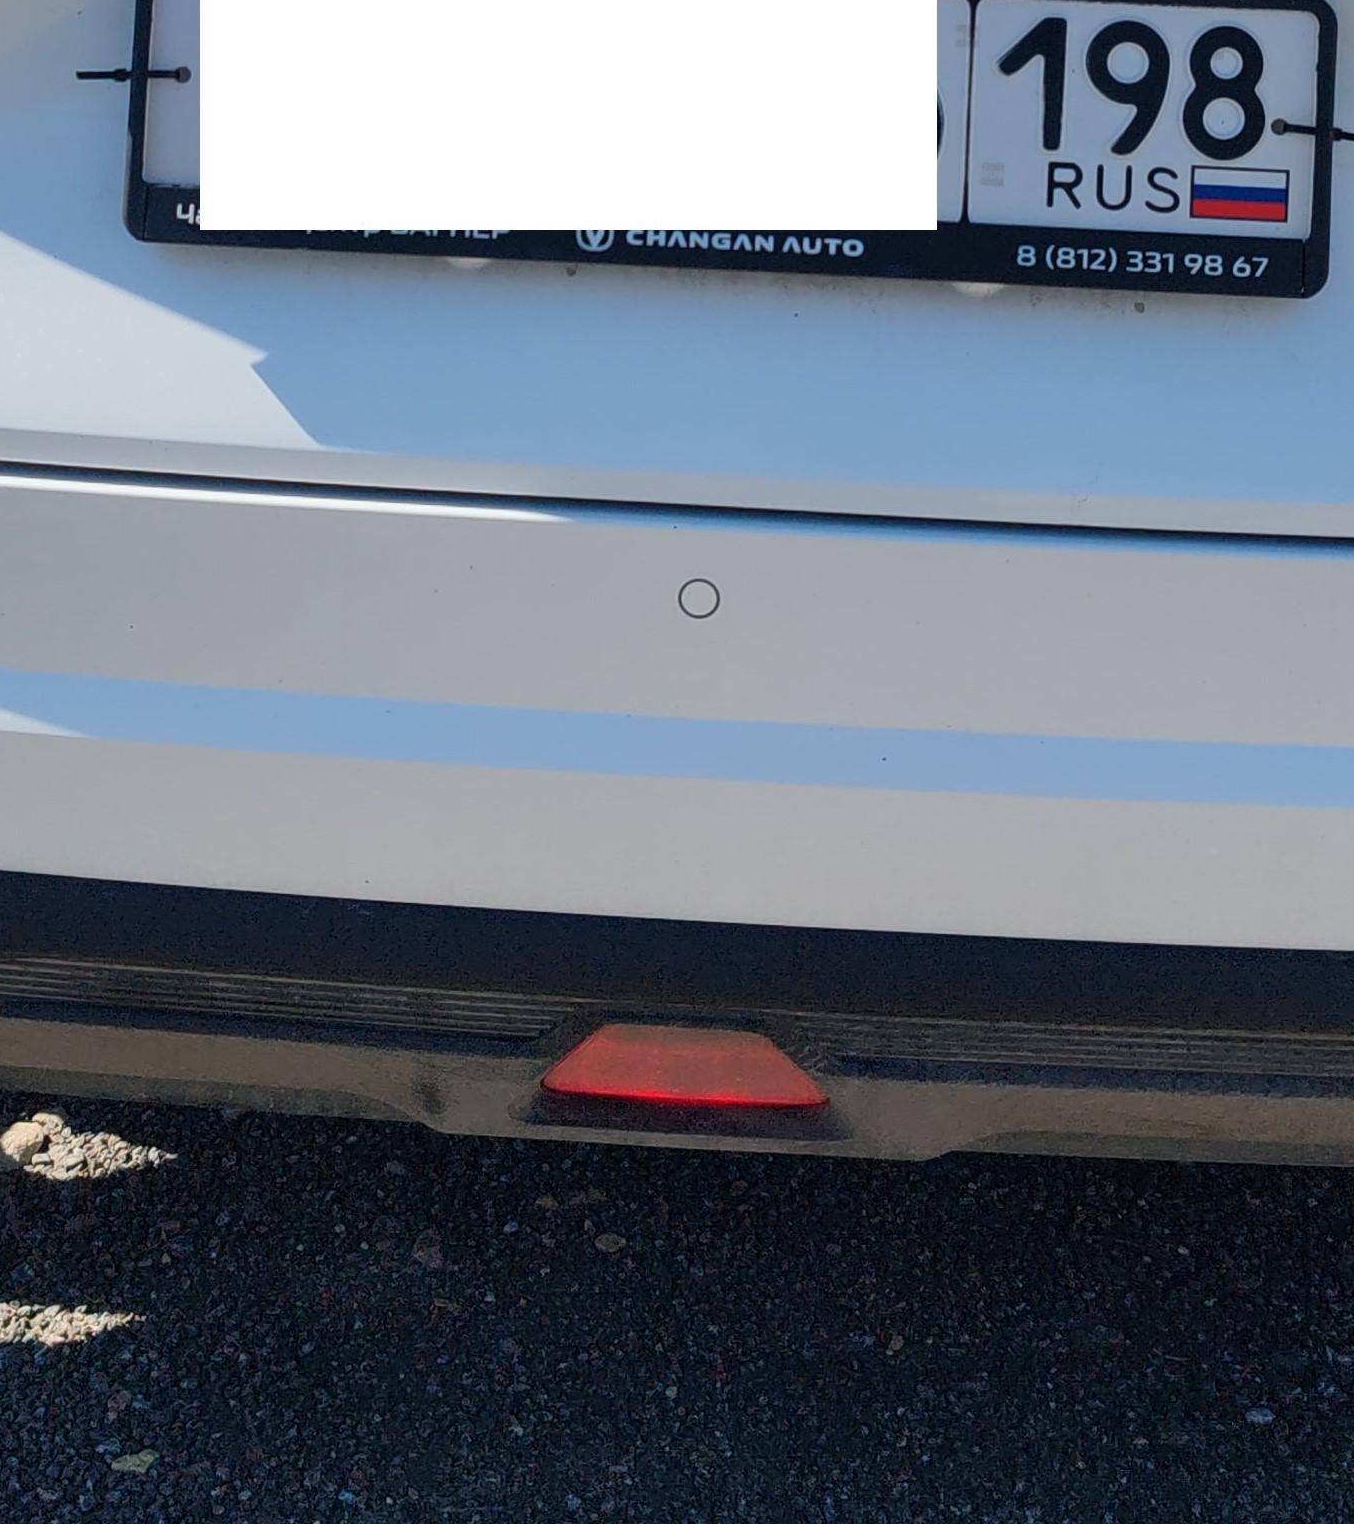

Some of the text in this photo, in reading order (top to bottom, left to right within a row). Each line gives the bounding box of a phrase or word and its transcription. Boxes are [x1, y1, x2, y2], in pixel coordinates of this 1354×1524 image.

[998, 17, 1266, 161] 198
[1047, 162, 1180, 213] RUS
[626, 230, 865, 258] CHANGAN AUTO
[1017, 244, 1269, 277] 8 (812) 331 98 67
